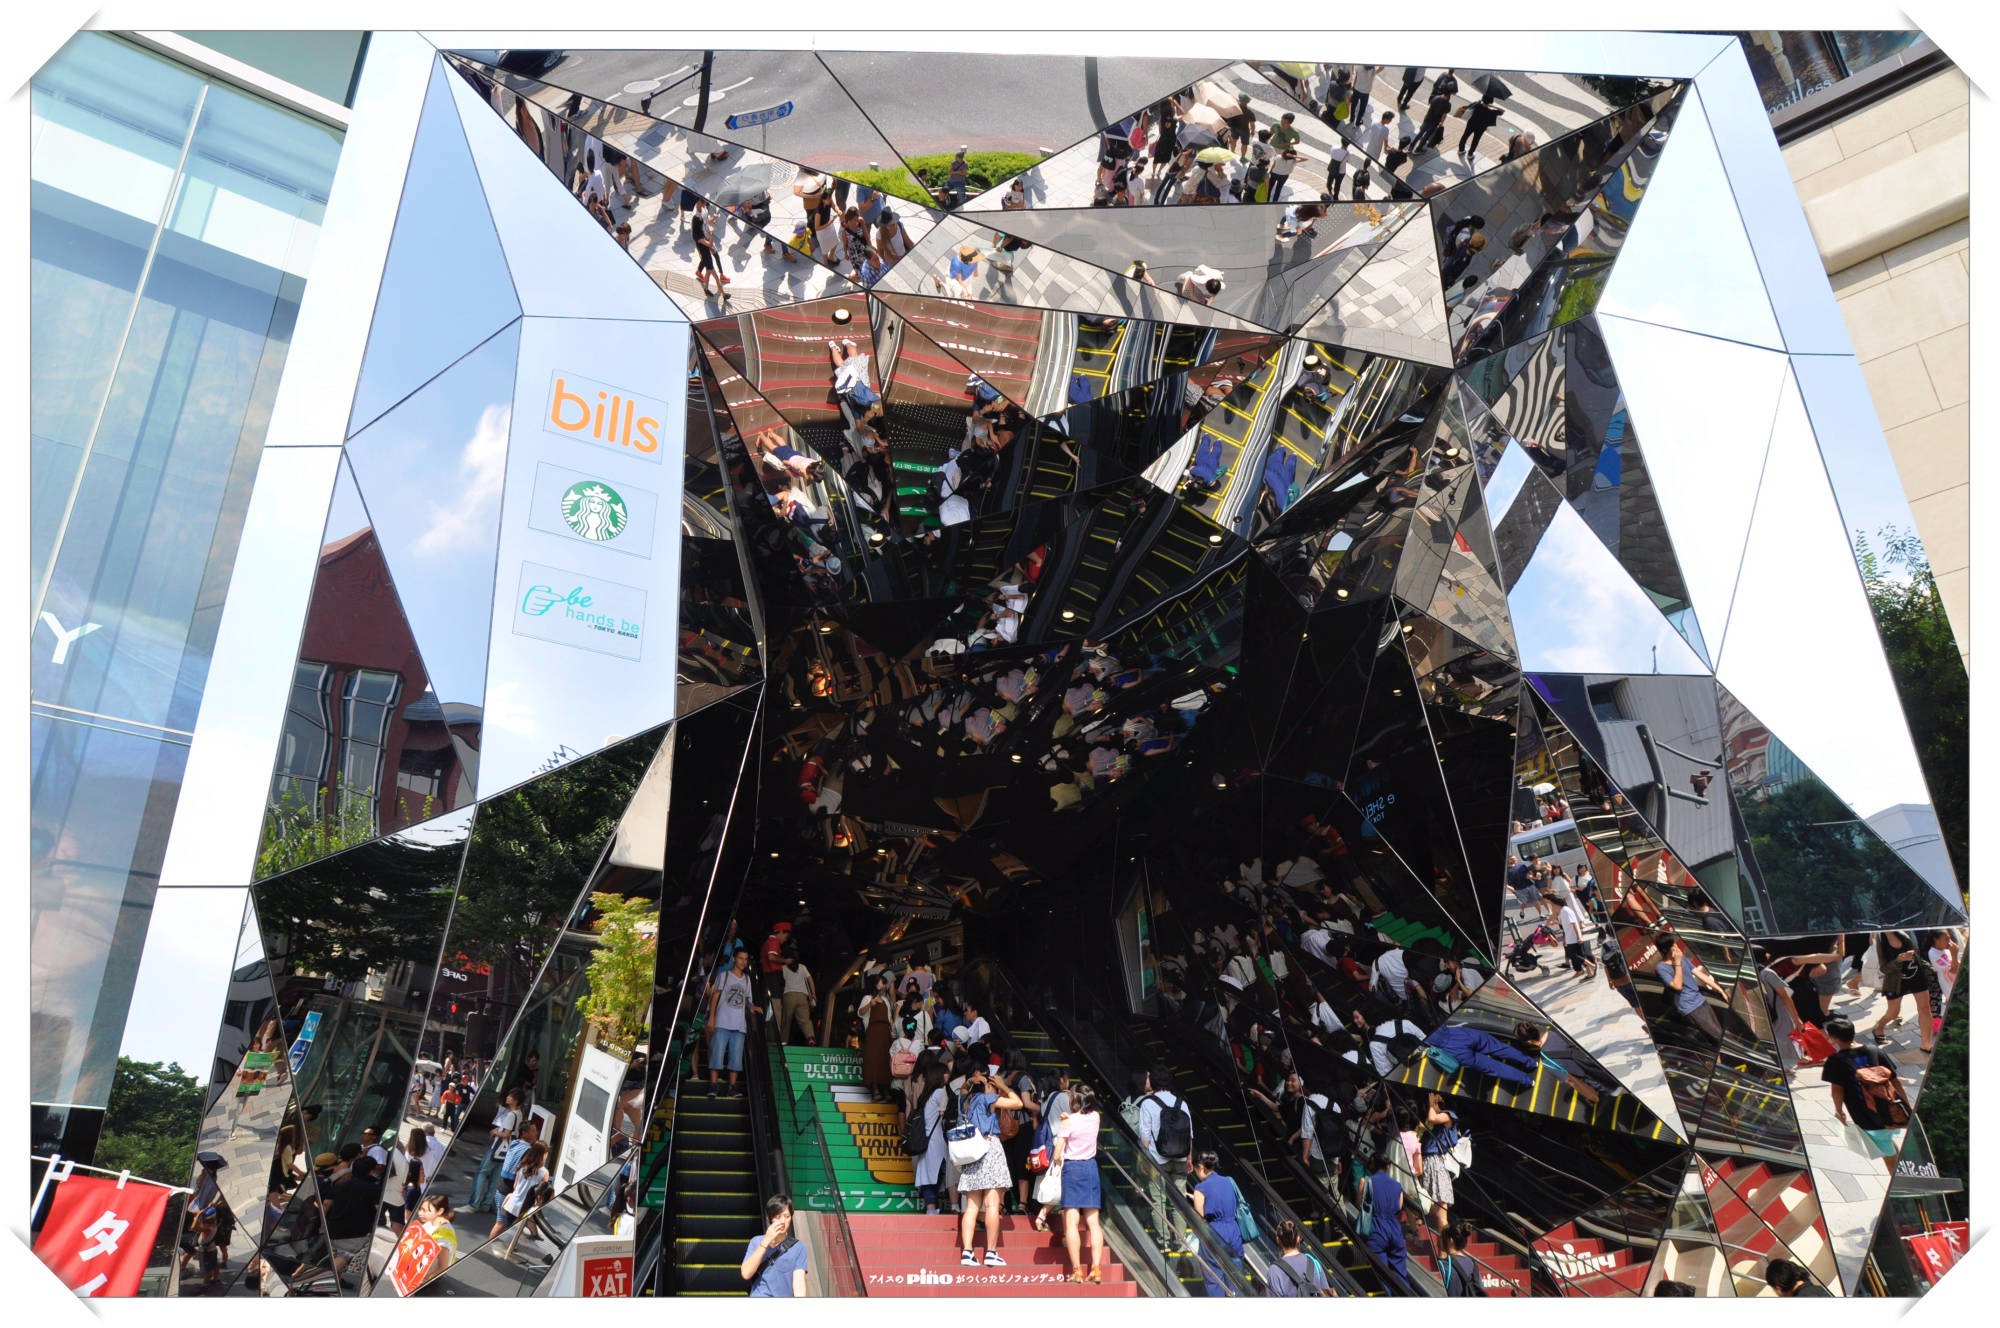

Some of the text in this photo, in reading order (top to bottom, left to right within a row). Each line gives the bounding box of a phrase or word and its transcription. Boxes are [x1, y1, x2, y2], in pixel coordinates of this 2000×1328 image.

[551, 378, 659, 453] bills
[566, 586, 593, 607] be
[566, 606, 640, 633] hands be
[40, 611, 102, 664] Y
[869, 1268, 1071, 1285] アイスの pino がつくったピノフォンデュの
